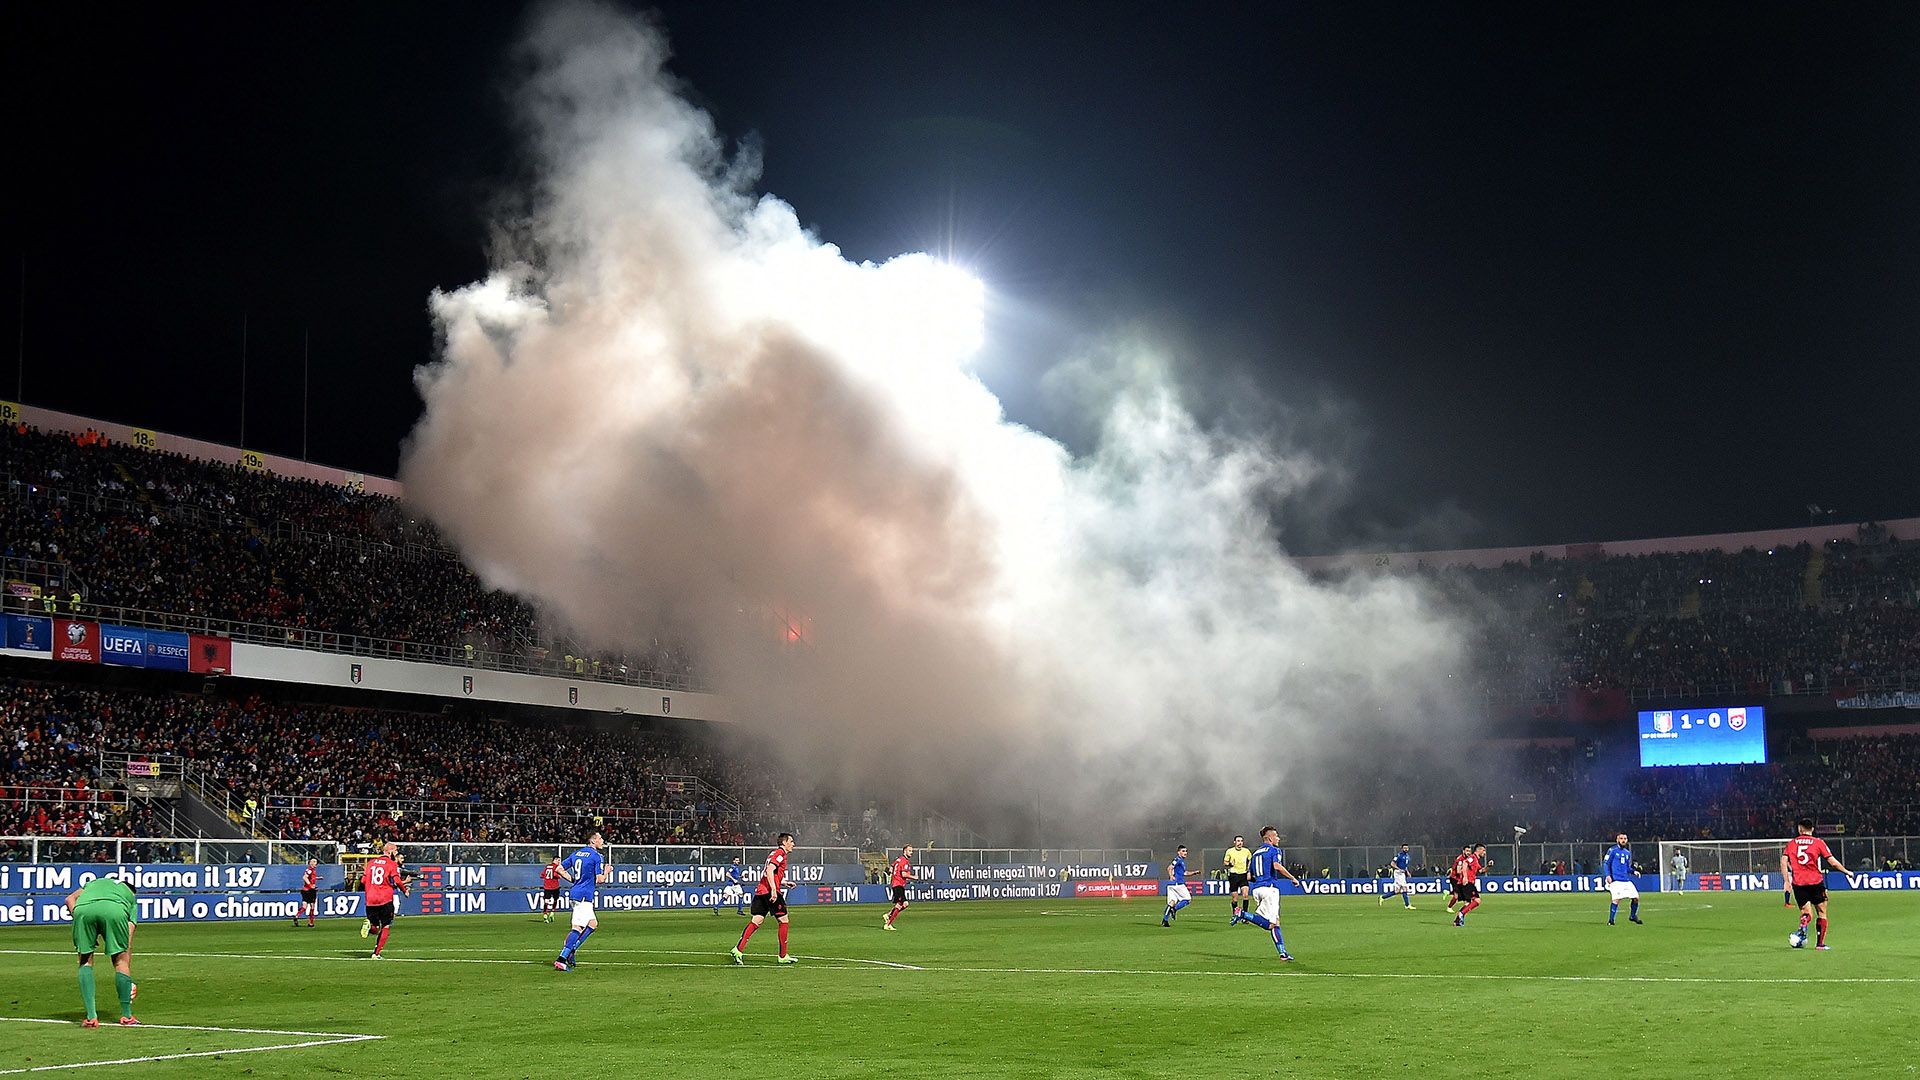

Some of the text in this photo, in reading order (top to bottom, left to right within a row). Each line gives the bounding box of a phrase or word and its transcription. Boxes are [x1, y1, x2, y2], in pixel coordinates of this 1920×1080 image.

[133, 431, 154, 446] 18G
[243, 453, 263, 468] 19D
[103, 637, 142, 654] UEFA
[157, 646, 188, 657] RESPECT
[1680, 713, 1693, 730] 1
[1708, 712, 1721, 729] 0
[1797, 845, 1809, 865] 5
[574, 858, 583, 880] 9
[912, 866, 935, 880] TIM
[949, 866, 974, 880] Vieni
[976, 865, 991, 879] nei
[993, 865, 1025, 881] negozi
[1027, 866, 1046, 878] TIM
[1048, 868, 1056, 878] o
[1113, 863, 1122, 877] il
[1125, 864, 1148, 877] 187
[1255, 854, 1264, 877] 11
[17, 867, 72, 889] TIM
[204, 865, 220, 888] il
[224, 867, 266, 888] 187
[370, 865, 385, 885] 18
[445, 866, 486, 886] TIM
[618, 866, 642, 883] nei
[646, 866, 695, 886] negozi
[698, 866, 725, 882] TIM
[792, 865, 801, 881] il
[803, 866, 824, 881] 187
[1726, 874, 1769, 890] TIM
[1845, 873, 1903, 889] Vieni
[834, 886, 859, 902] TIM
[936, 885, 970, 901] negozi
[972, 885, 991, 898] TIM
[992, 889, 1000, 898] o
[1001, 884, 1036, 898] chiama
[1038, 884, 1044, 897] il
[1045, 884, 1061, 896] 187
[1301, 880, 1346, 894] Vieni
[1351, 879, 1378, 893] nei
[1383, 879, 1441, 895] ngozi
[1486, 880, 1499, 892] o
[1503, 877, 1572, 892] chiama
[1577, 876, 1590, 891] il
[137, 898, 185, 919] TIM
[192, 902, 208, 918] o
[215, 896, 299, 918] chiama
[323, 895, 360, 915] 187
[445, 893, 486, 912] TIM
[603, 889, 654, 910] negozi
[658, 890, 686, 906] TIM
[690, 894, 699, 906] o
